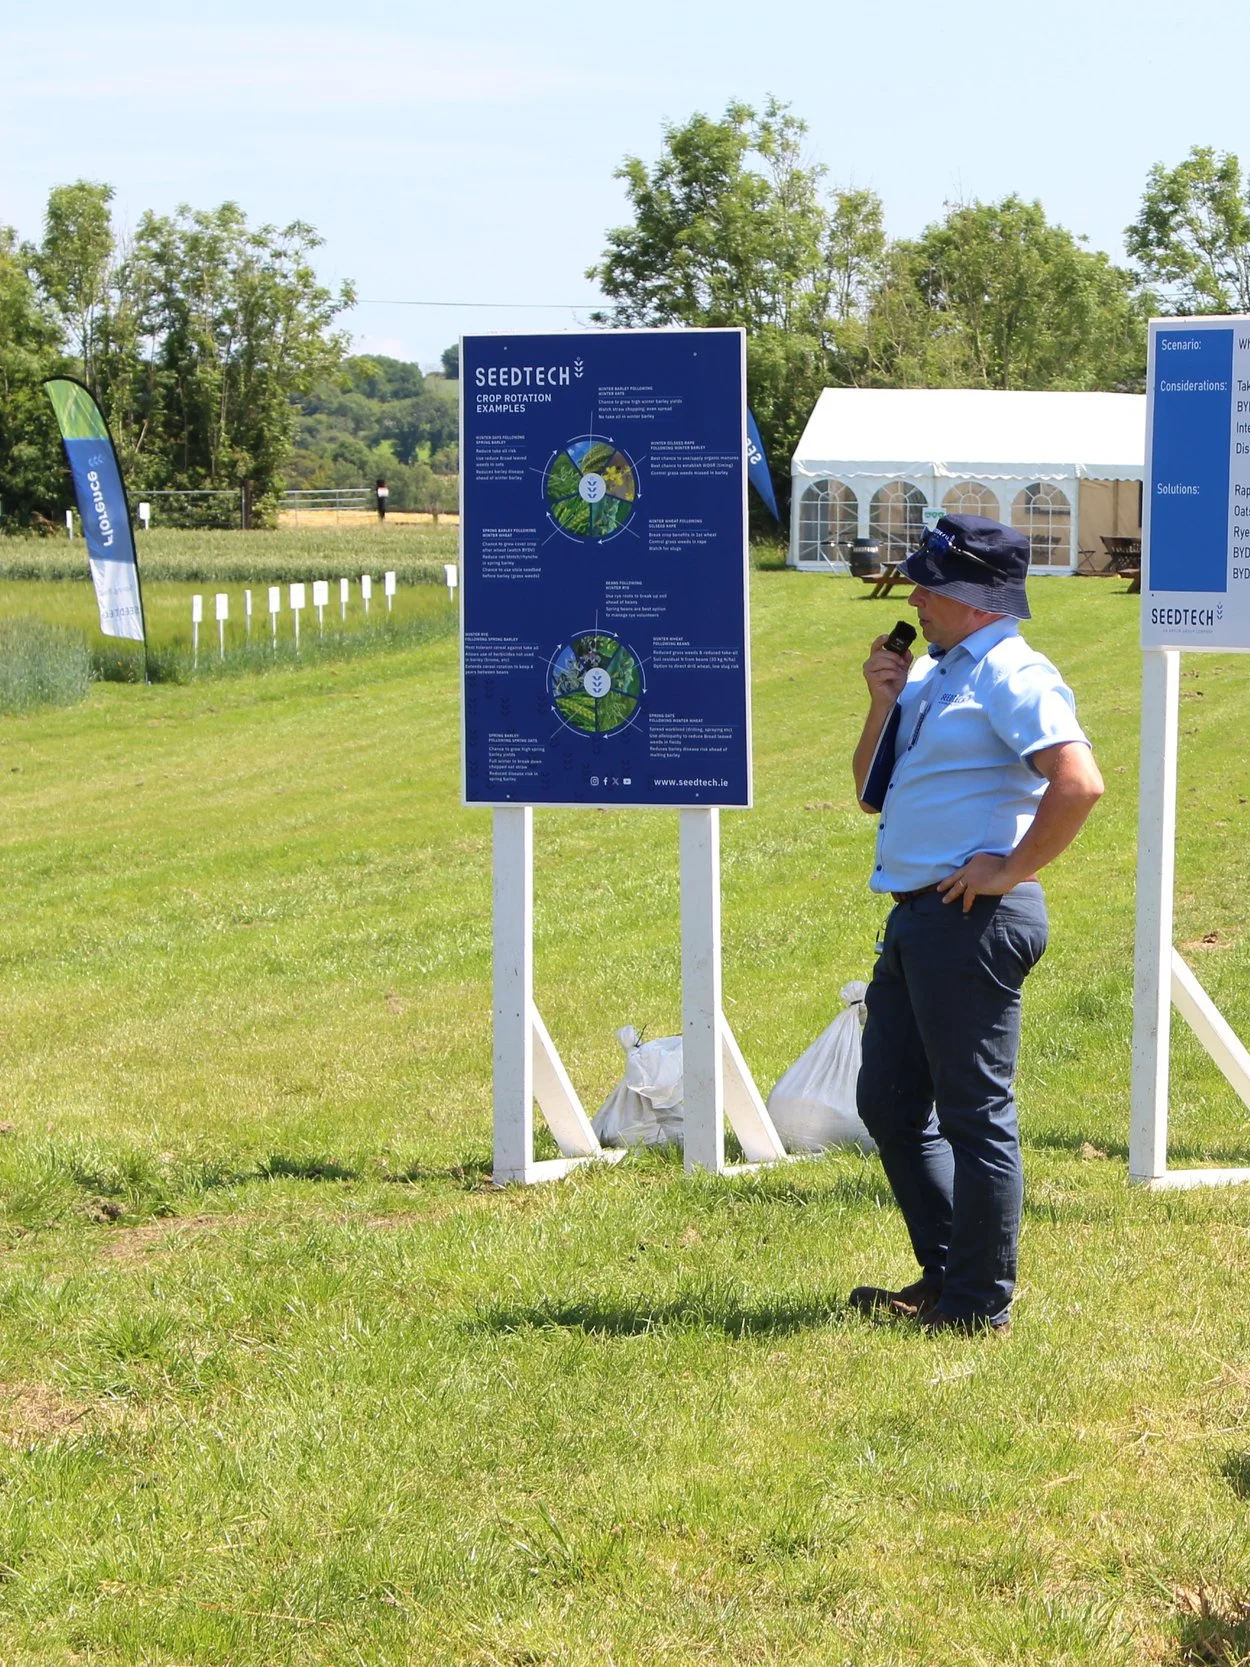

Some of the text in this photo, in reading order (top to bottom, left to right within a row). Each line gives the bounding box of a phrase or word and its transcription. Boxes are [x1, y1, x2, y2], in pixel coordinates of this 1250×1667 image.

[1161, 338, 1201, 350] Scenario:
[475, 366, 569, 386] SEEDTECH
[1160, 379, 1227, 391] Considerations:
[476, 393, 551, 402] CROP ROTATION
[476, 403, 525, 412] EXAMPLES
[1156, 482, 1199, 494] Solutions:
[1233, 525, 1250, 540] Rye
[1151, 607, 1213, 626] SEEDTECH
[653, 778, 728, 786] www.seedtech.ie
